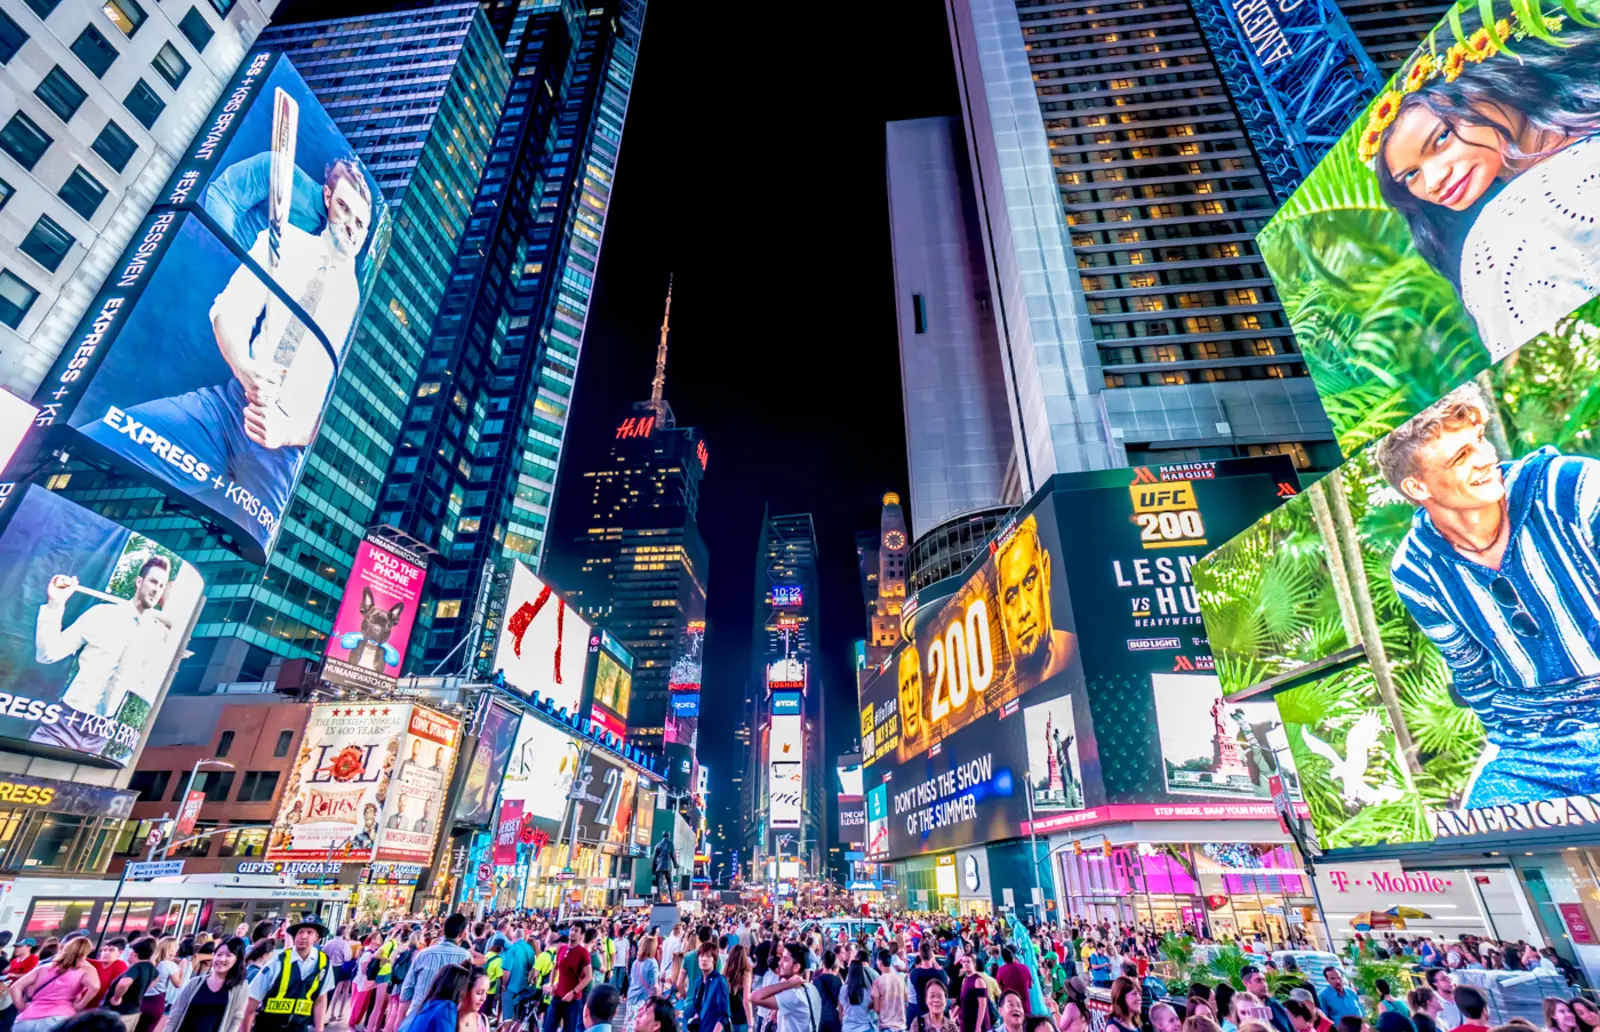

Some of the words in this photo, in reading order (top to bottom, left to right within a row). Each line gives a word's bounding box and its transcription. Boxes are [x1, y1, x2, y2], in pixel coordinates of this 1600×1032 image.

[222, 86, 246, 113] KRIS
[194, 110, 236, 161] BRYANT
[64, 297, 125, 384] EXPRESS
[616, 416, 655, 440] H&M
[102, 405, 210, 484] EXPRESS
[225, 481, 262, 516] KRIS
[1160, 462, 1217, 474] MARRIOTT
[1161, 470, 1215, 482] MARQUIS
[1140, 488, 1188, 507] UFC
[1136, 509, 1206, 541] 200
[367, 534, 427, 569] HUMANEWATCH.ORG
[369, 549, 399, 569] HOLD
[400, 562, 419, 580] THE
[373, 562, 410, 586] PHONE
[774, 587, 800, 597] 10:22
[1131, 597, 1150, 612] VS
[1130, 640, 1154, 649] BUD
[1154, 639, 1179, 649] LIGHT
[927, 599, 994, 722] 200
[324, 664, 396, 691] HUMANEWATCH.ORG
[80, 713, 118, 739] KRIS
[338, 727, 355, 735] 400
[530, 690, 579, 730] 1540
[581, 718, 655, 772] BROADWAY
[863, 733, 877, 762] 200
[894, 786, 916, 814] DON'T
[917, 779, 938, 807] MISS
[938, 770, 956, 799] THE
[958, 753, 993, 795] SHOW
[907, 815, 918, 835] OF
[919, 808, 935, 832] THE
[935, 797, 977, 828] SUMMER
[1154, 807, 1174, 816] STEP
[1175, 807, 1203, 816] INSIDE.
[1203, 806, 1225, 815] SNAP
[1225, 806, 1248, 815] YOUR
[1435, 794, 1600, 838] AMERICAN
[498, 818, 520, 835] JERSEY
[498, 832, 514, 846] BOYS
[238, 863, 274, 873] GIFTS
[282, 862, 342, 874] LUGGAGE
[268, 1000, 292, 1010] TIMES
